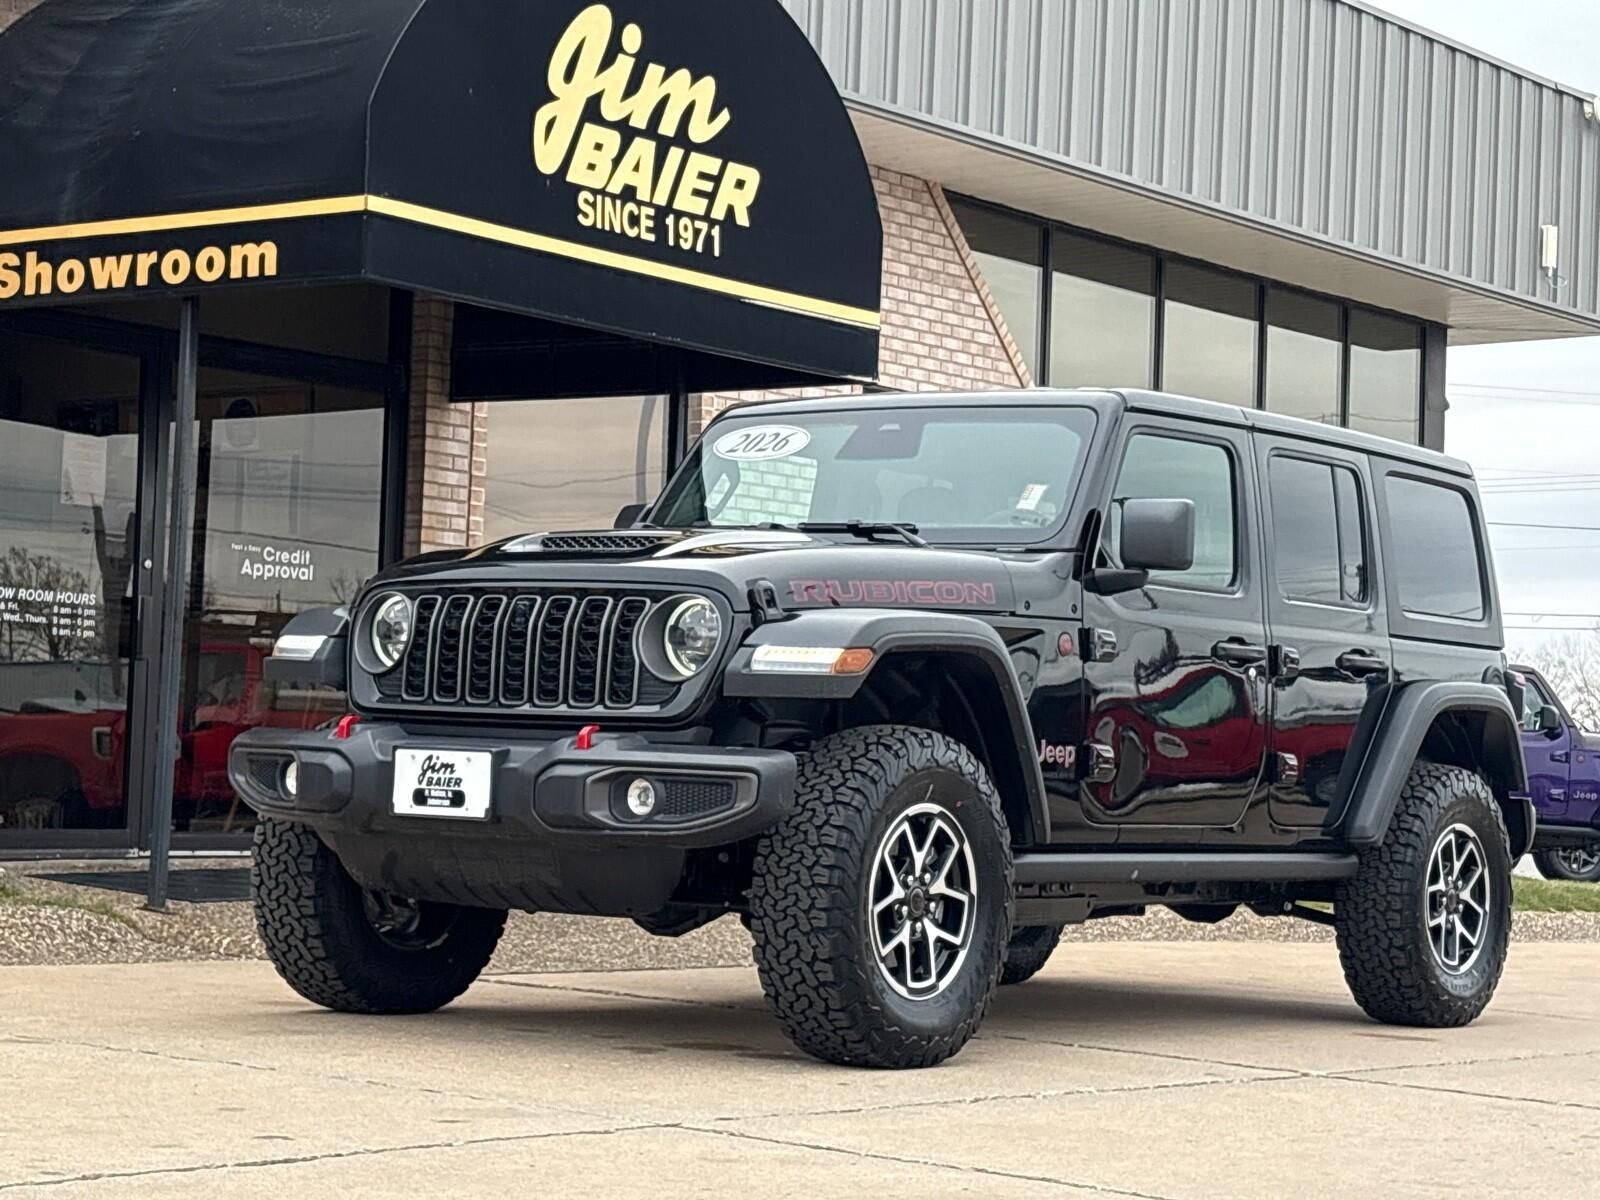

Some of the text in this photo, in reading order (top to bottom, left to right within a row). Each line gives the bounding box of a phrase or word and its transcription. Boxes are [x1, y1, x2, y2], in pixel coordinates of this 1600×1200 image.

[533, 3, 730, 175] Jim
[565, 121, 760, 228] BAIER
[576, 190, 720, 257] SINCE 1971
[0, 241, 278, 299] Showroom
[724, 431, 799, 453] 2026
[263, 546, 310, 565] Credit
[240, 558, 314, 581] Approval
[18, 588, 54, 602] ROOM
[56, 591, 97, 605] HOURS
[788, 580, 997, 605] RUBICON
[60, 607, 72, 615] am
[83, 609, 96, 617] pm
[59, 629, 71, 637] am
[82, 630, 95, 640] pm
[83, 619, 96, 628] pm
[1039, 739, 1076, 768] Jeep
[417, 754, 456, 786] Jim
[425, 776, 463, 788] BAIER
[1573, 790, 1598, 801] Jeep
